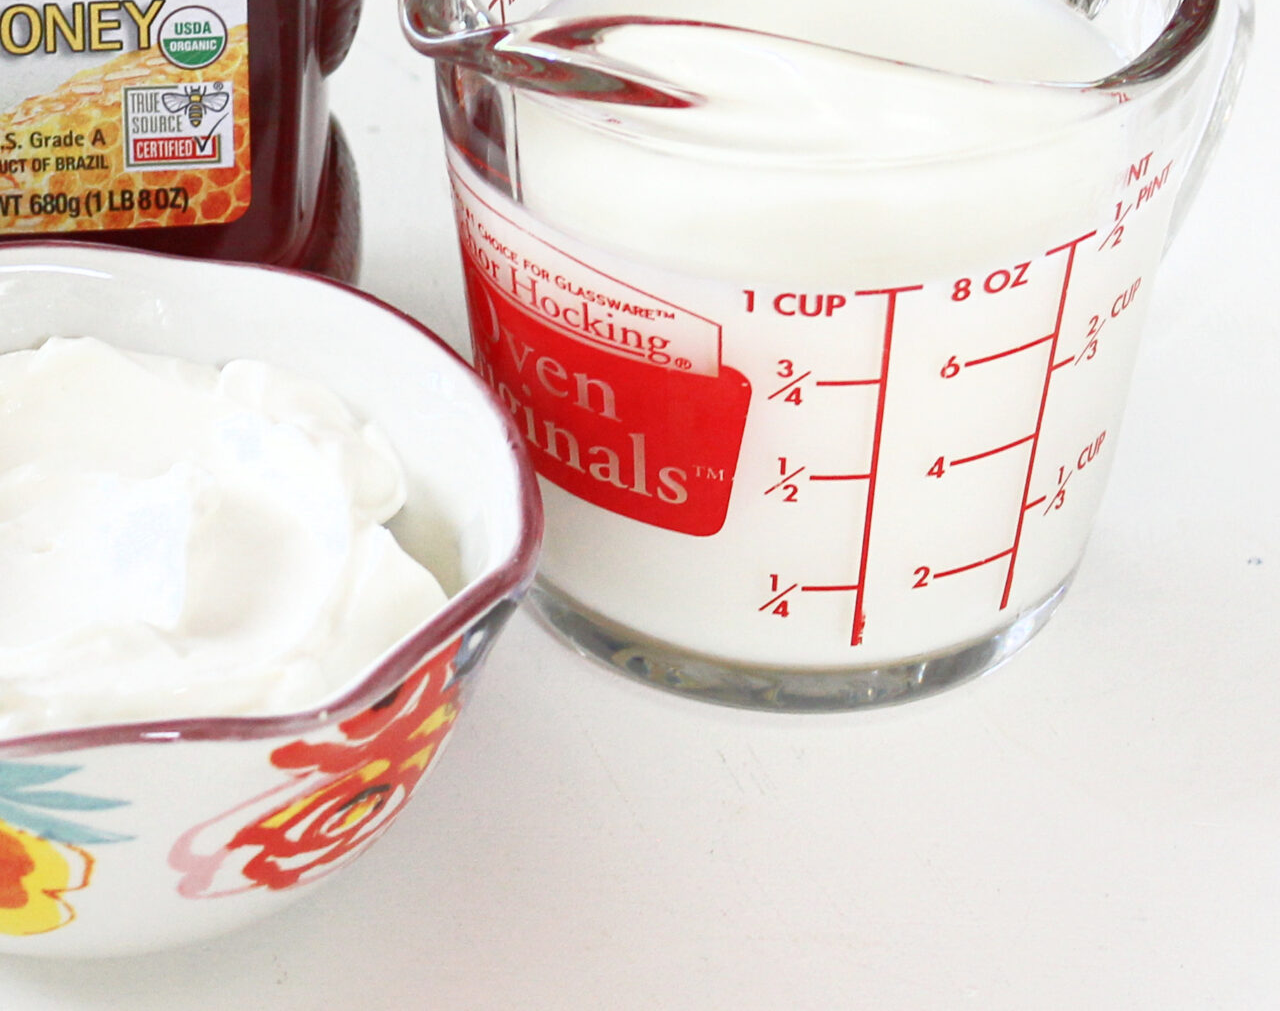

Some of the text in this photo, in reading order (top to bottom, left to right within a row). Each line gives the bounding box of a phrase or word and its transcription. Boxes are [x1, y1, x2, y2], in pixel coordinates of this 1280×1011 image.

[174, 21, 212, 35] USDA
[169, 39, 217, 53] ORGANIC
[131, 92, 161, 113] TRUE
[132, 114, 183, 134] SOURCE
[30, 130, 85, 149] Grade
[91, 129, 106, 146] A
[136, 139, 193, 160] CERTIFIED
[32, 157, 51, 172] OF
[55, 155, 109, 172] BRAZIL
[1135, 159, 1174, 210] PINT
[29, 193, 81, 218] 680g
[108, 189, 135, 212] LB
[137, 189, 152, 210] 8
[152, 187, 190, 213] OZ)
[523, 258, 550, 282] FOR
[951, 261, 1032, 302] 8 OZ
[743, 290, 847, 318] 1 CUP
[1110, 277, 1142, 319] CUP
[940, 355, 961, 379] 6
[1076, 430, 1107, 470] CUP
[926, 456, 946, 479] 4
[911, 566, 931, 589] 2
